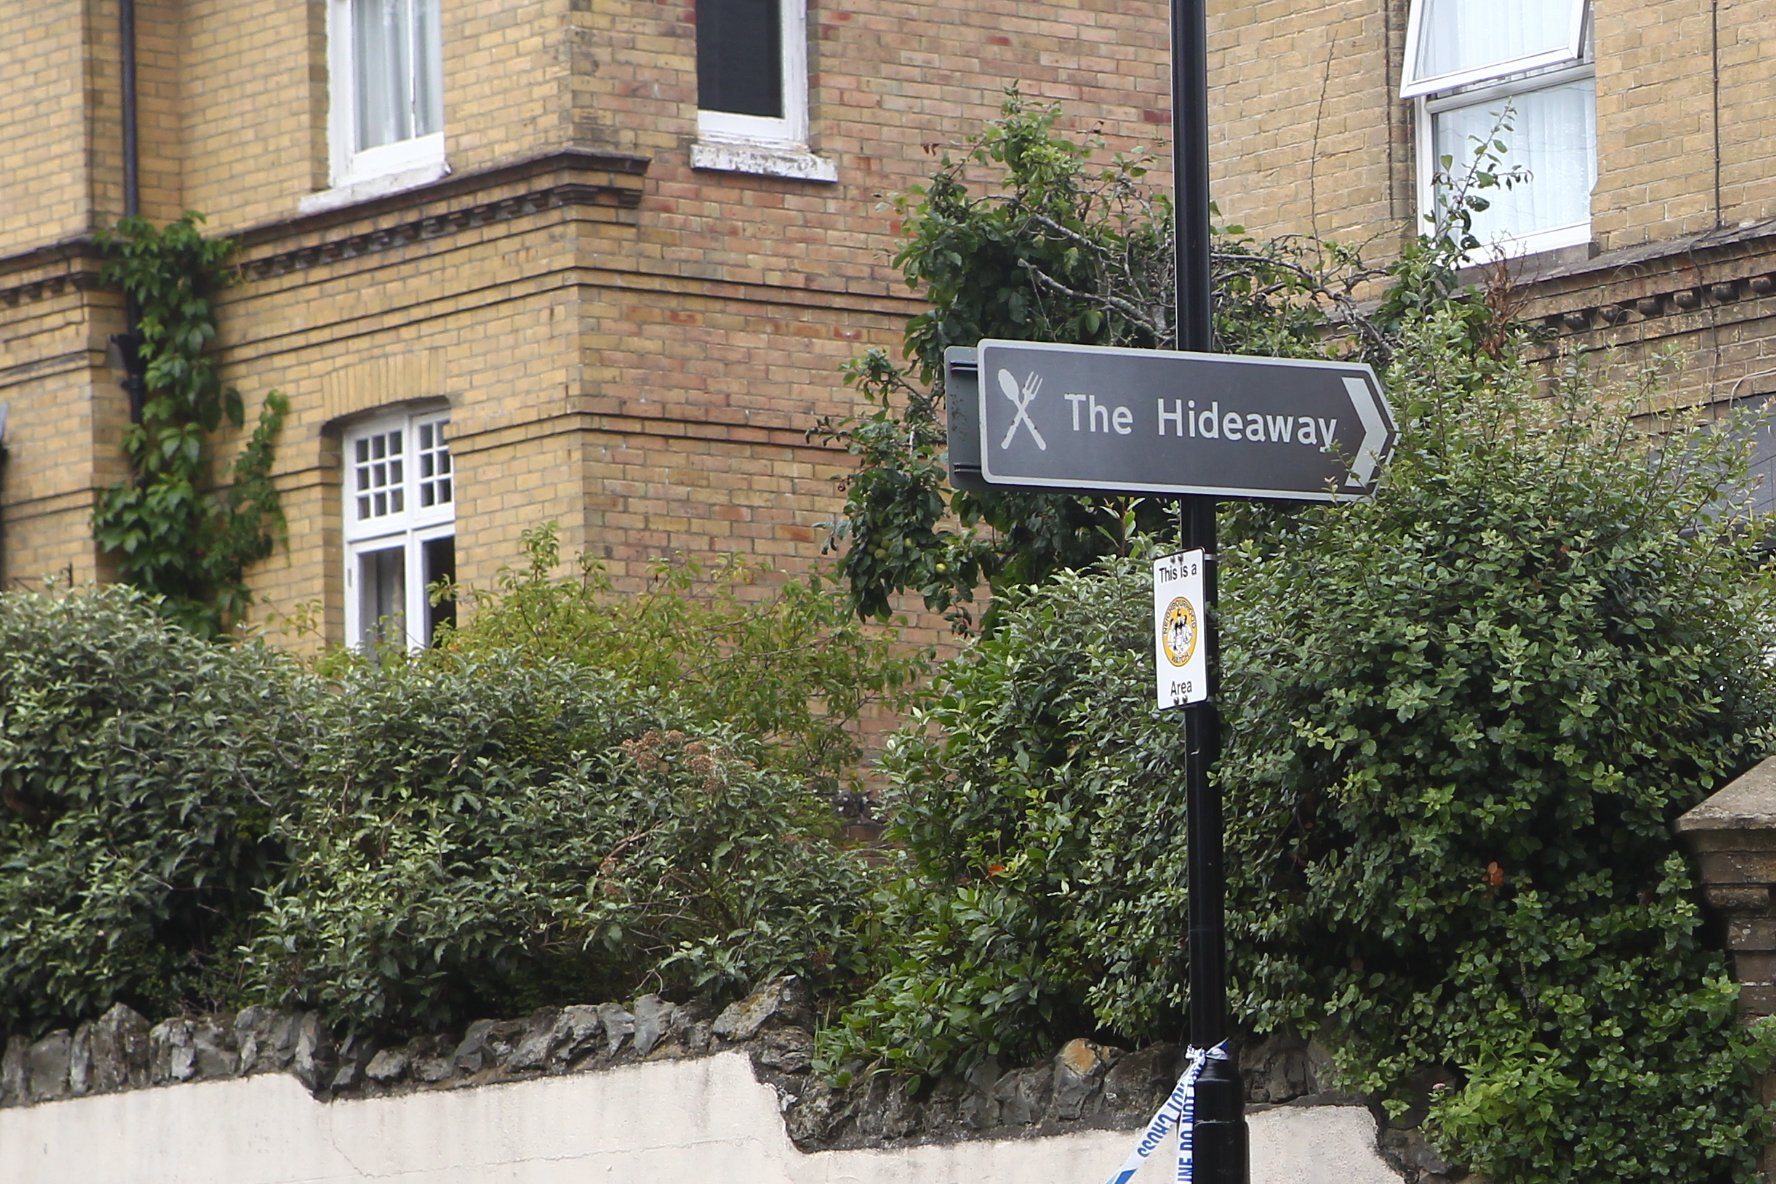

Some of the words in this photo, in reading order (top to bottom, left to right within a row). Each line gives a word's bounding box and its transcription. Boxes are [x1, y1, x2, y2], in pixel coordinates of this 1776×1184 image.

[1064, 393, 1134, 435] The
[1157, 398, 1338, 453] Hideaway
[1158, 565, 1178, 583] This
[1180, 562, 1189, 578] is
[1191, 563, 1197, 576] a
[1171, 651, 1190, 663] WATCH
[1170, 681, 1193, 697] Area
